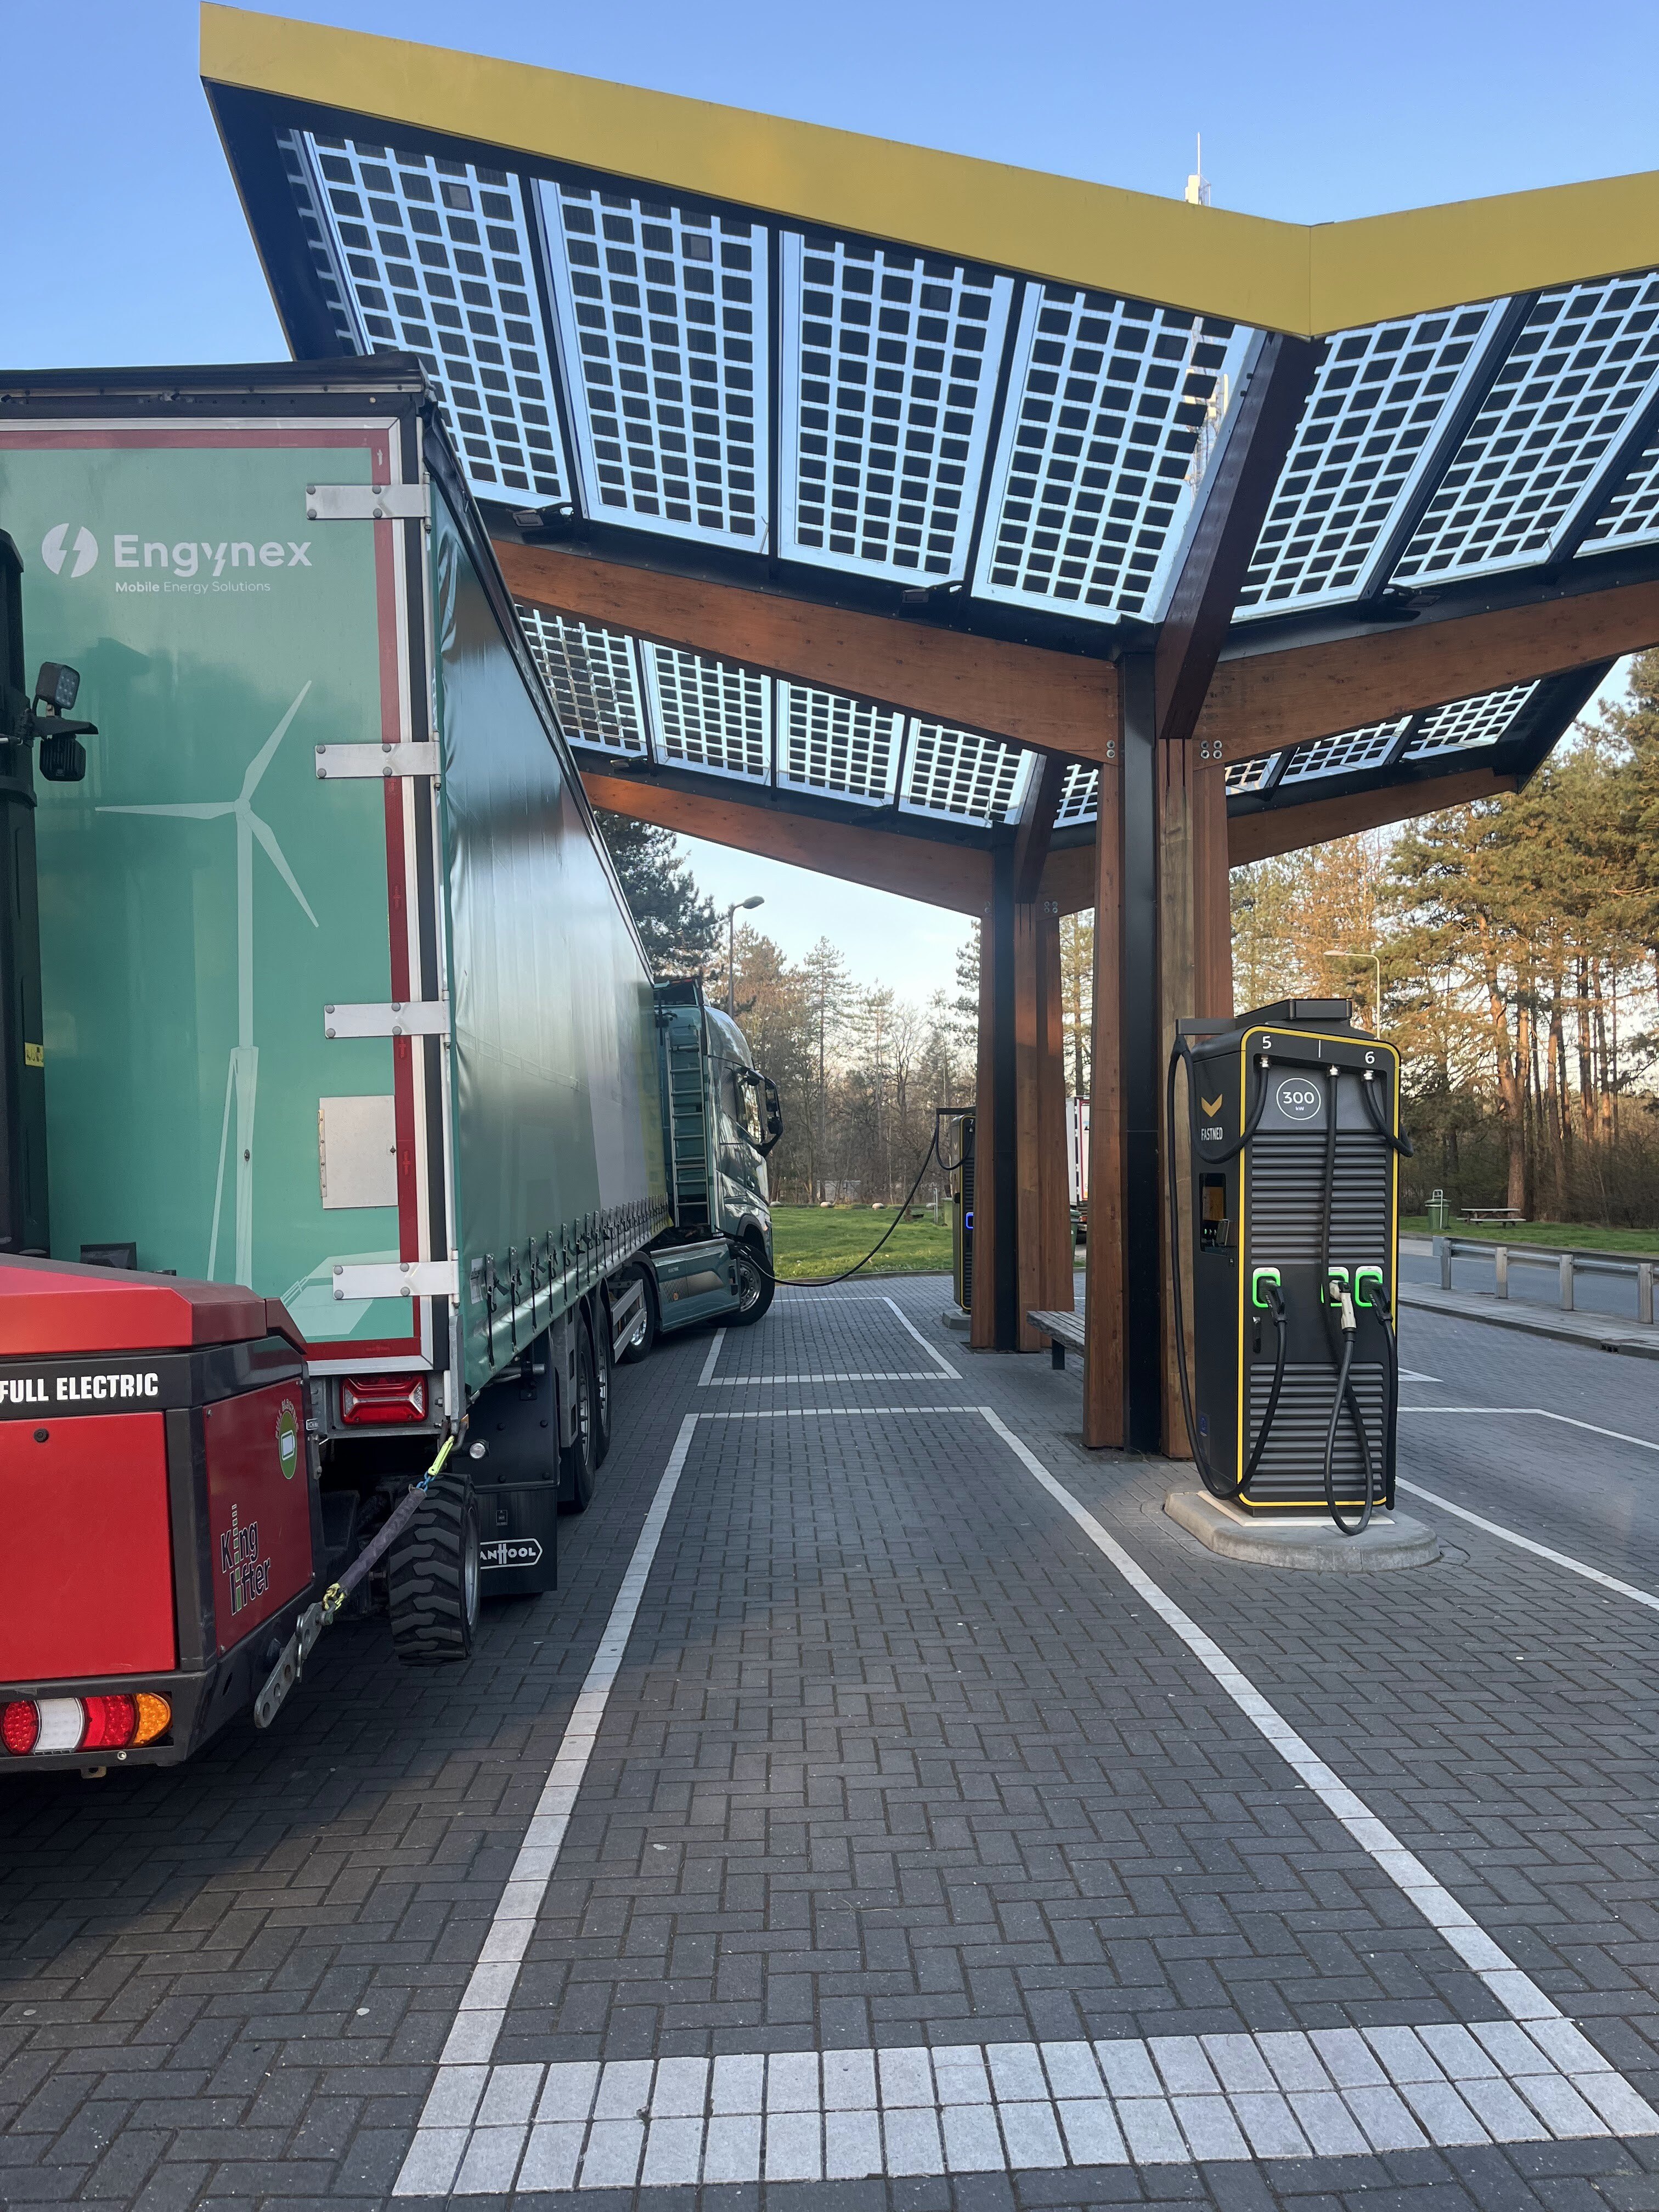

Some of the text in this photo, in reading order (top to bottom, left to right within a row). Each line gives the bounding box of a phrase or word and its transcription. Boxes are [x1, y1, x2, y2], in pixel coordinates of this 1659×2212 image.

[114, 534, 313, 577] Engynex
[115, 581, 270, 594] Mobile Energy Solutions
[1262, 1035, 1272, 1049] 5
[1364, 1051, 1375, 1064] 6
[1283, 1091, 1314, 1104] 300
[1201, 1127, 1223, 1141] FASTNED
[0, 1373, 159, 1403] FULL ELECTRIC
[221, 1504, 259, 1574] King
